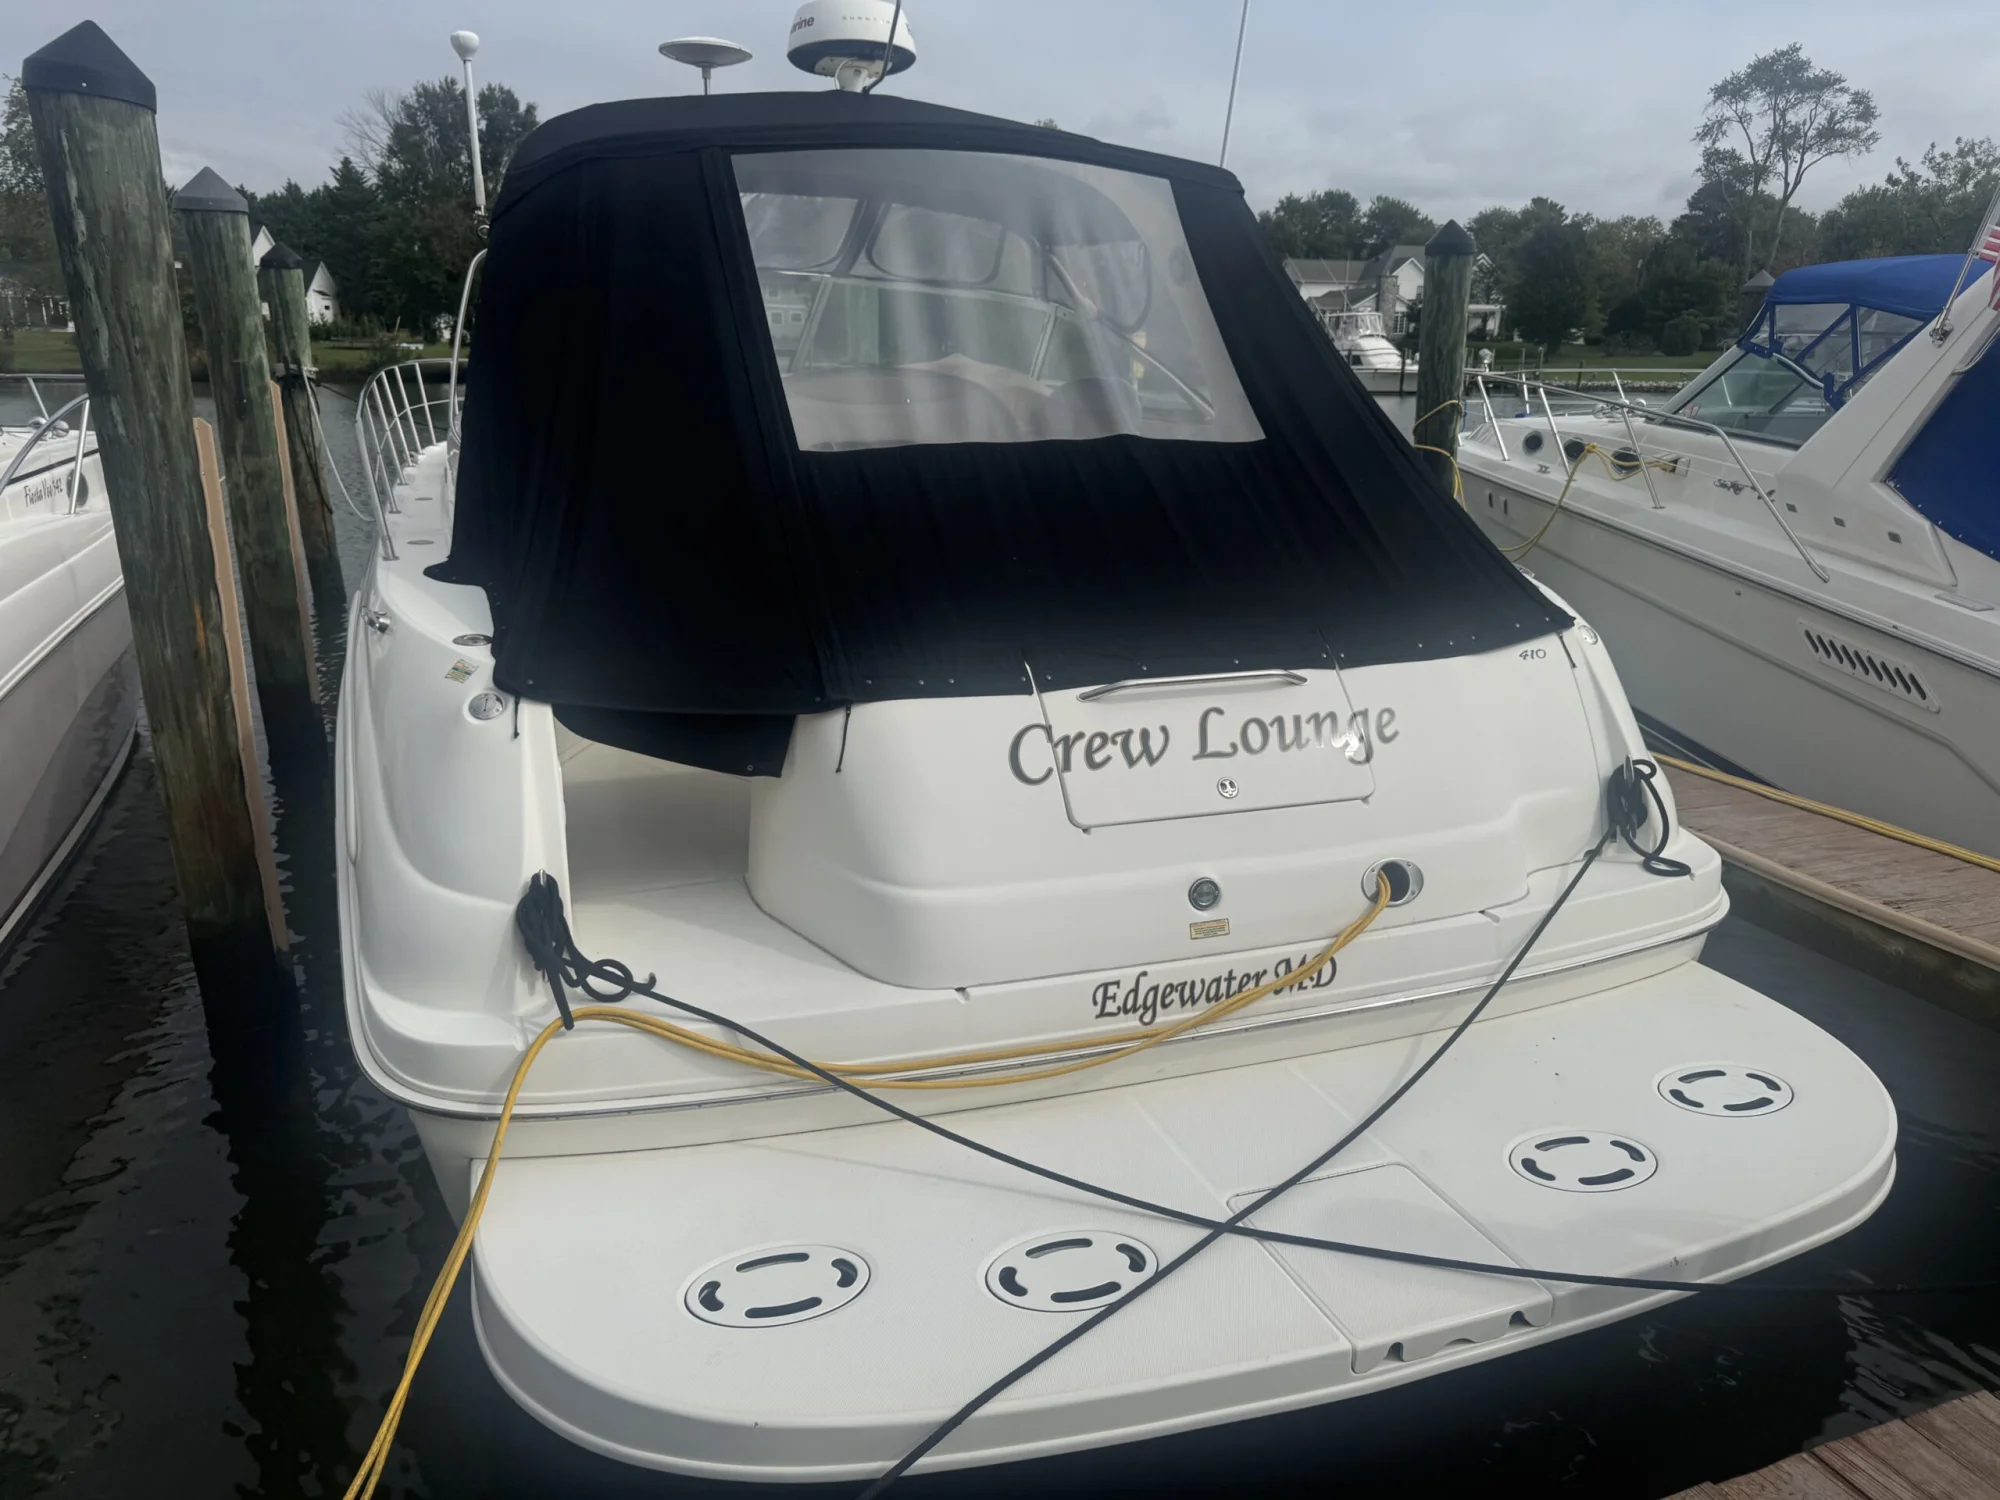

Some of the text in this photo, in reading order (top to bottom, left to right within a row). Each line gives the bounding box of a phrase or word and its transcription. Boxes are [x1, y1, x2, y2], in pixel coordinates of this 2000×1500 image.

[1519, 648, 1547, 660] 410
[1008, 706, 1400, 786] Crew Lounge
[1092, 970, 1268, 1026] Edgewater
